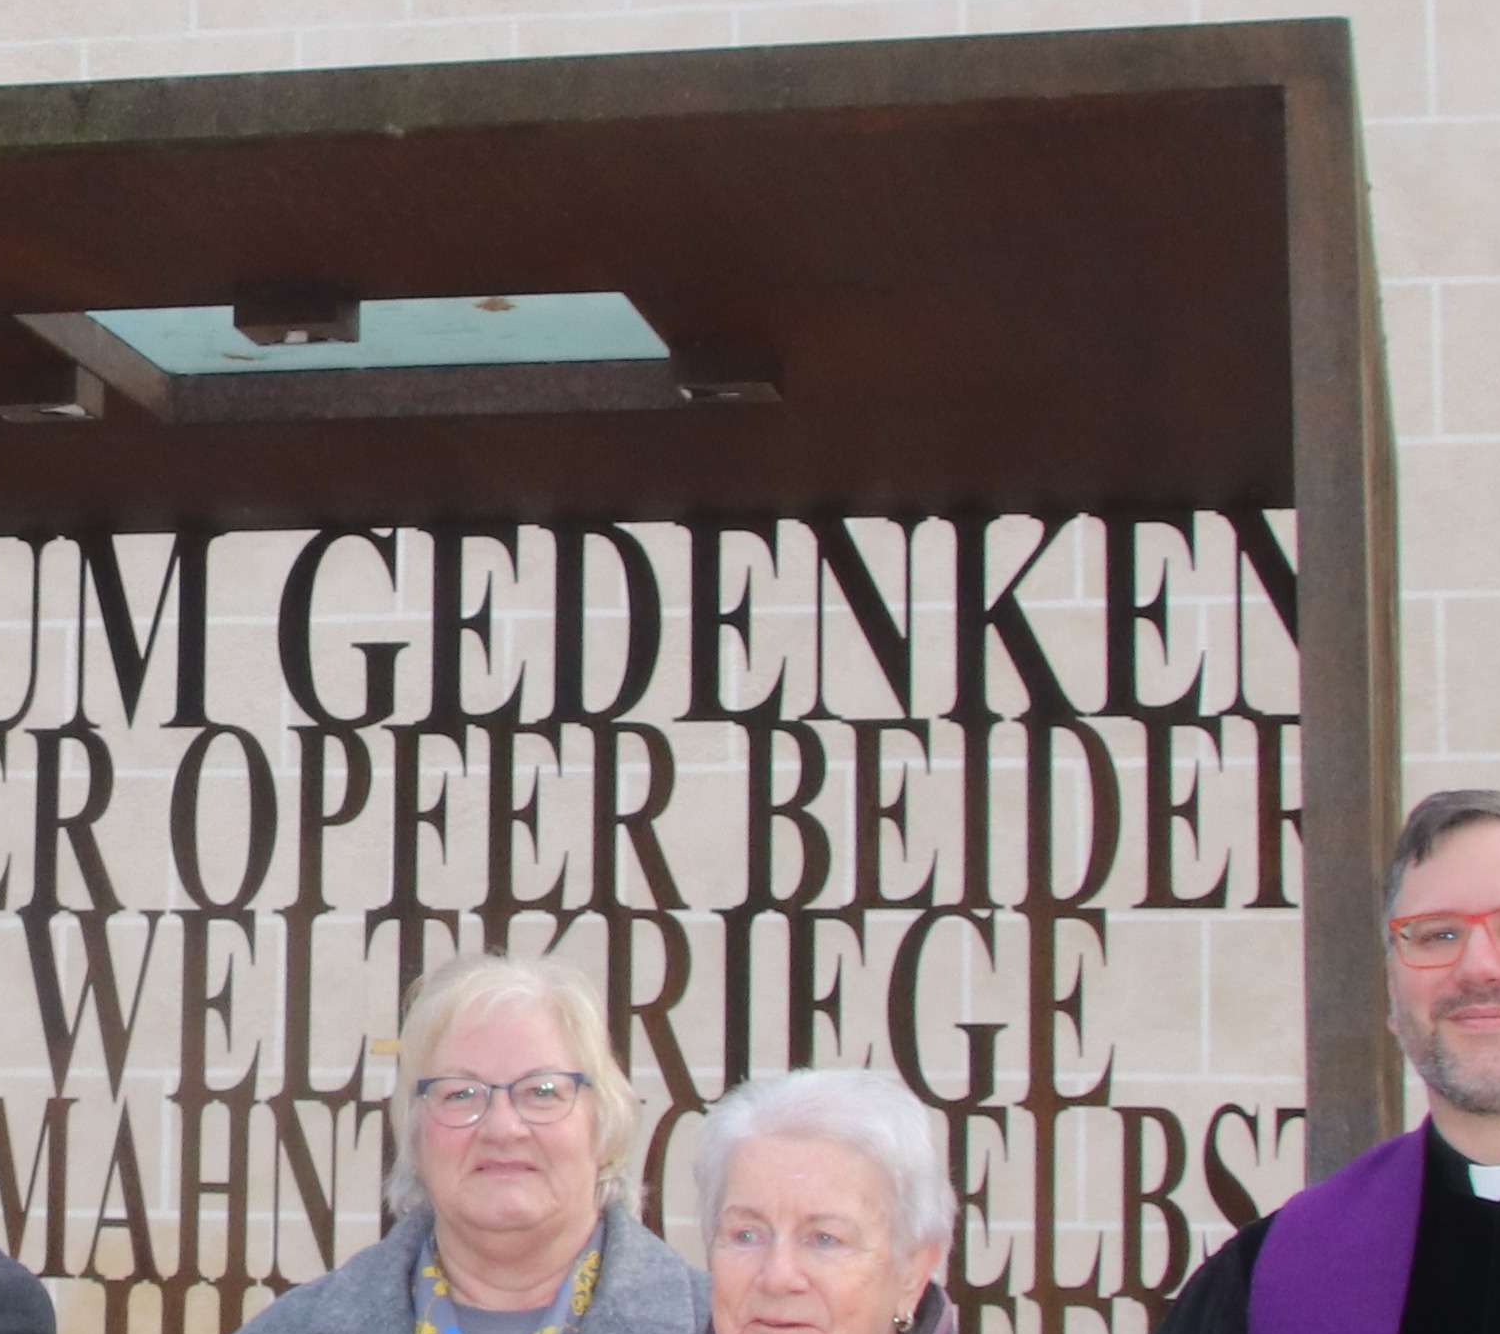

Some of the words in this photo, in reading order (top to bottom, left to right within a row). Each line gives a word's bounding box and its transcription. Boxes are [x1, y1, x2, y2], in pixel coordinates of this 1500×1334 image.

[277, 507, 1300, 728] GEDENKEN
[168, 720, 690, 913] OPFER
[709, 714, 1304, 911] BEIDER
[14, 905, 1116, 1107] WELTRIEGE
